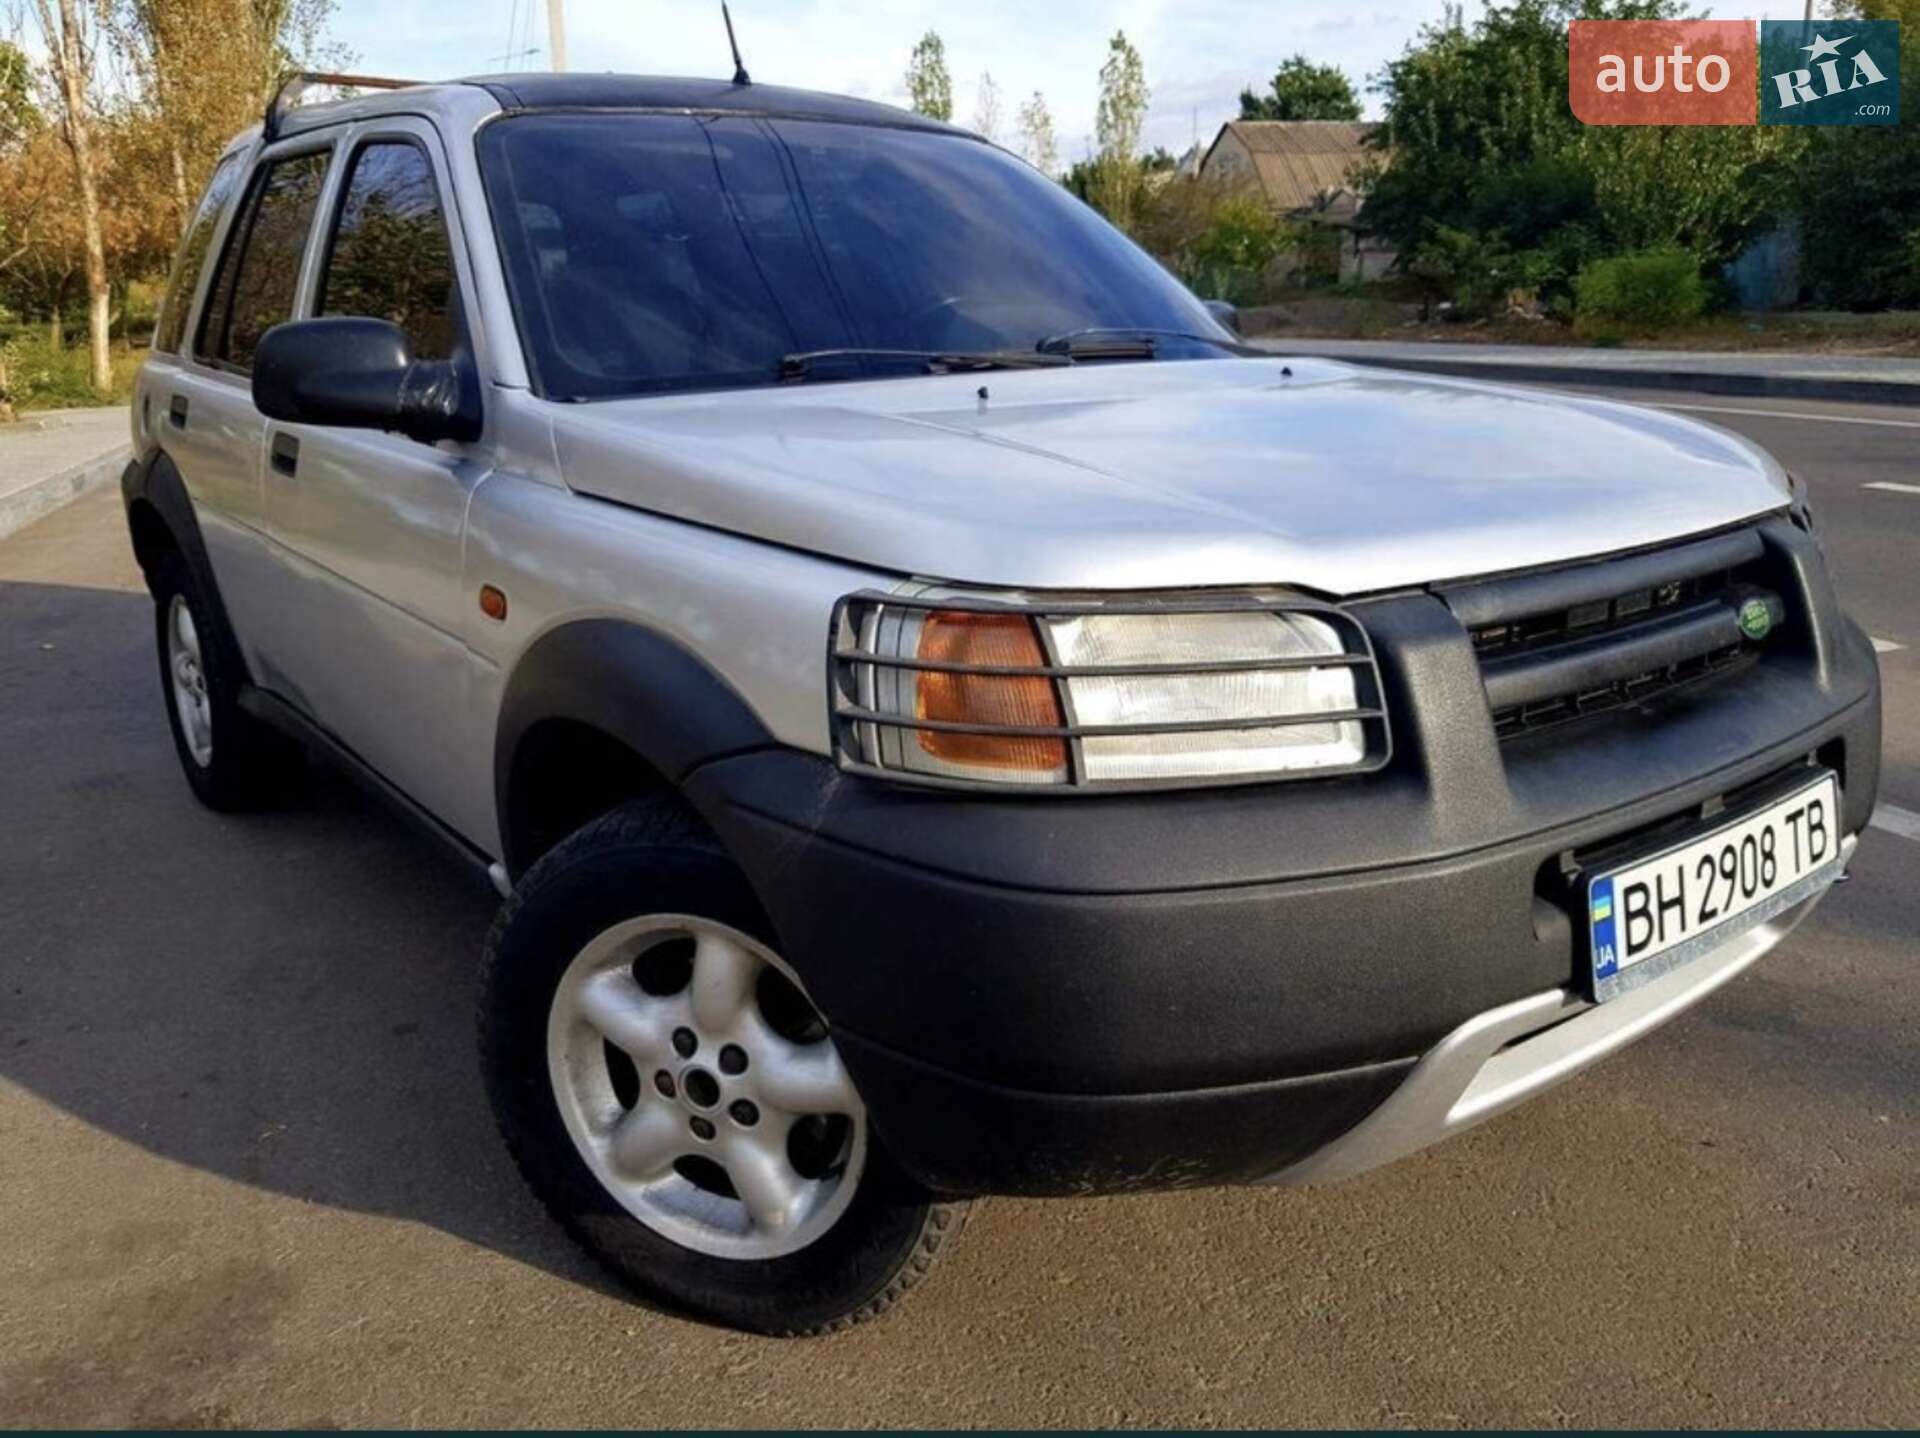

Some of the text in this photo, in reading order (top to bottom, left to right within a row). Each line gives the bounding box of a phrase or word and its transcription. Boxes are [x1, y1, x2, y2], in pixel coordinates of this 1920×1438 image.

[1622, 798, 1828, 957] BH 2908 TB
